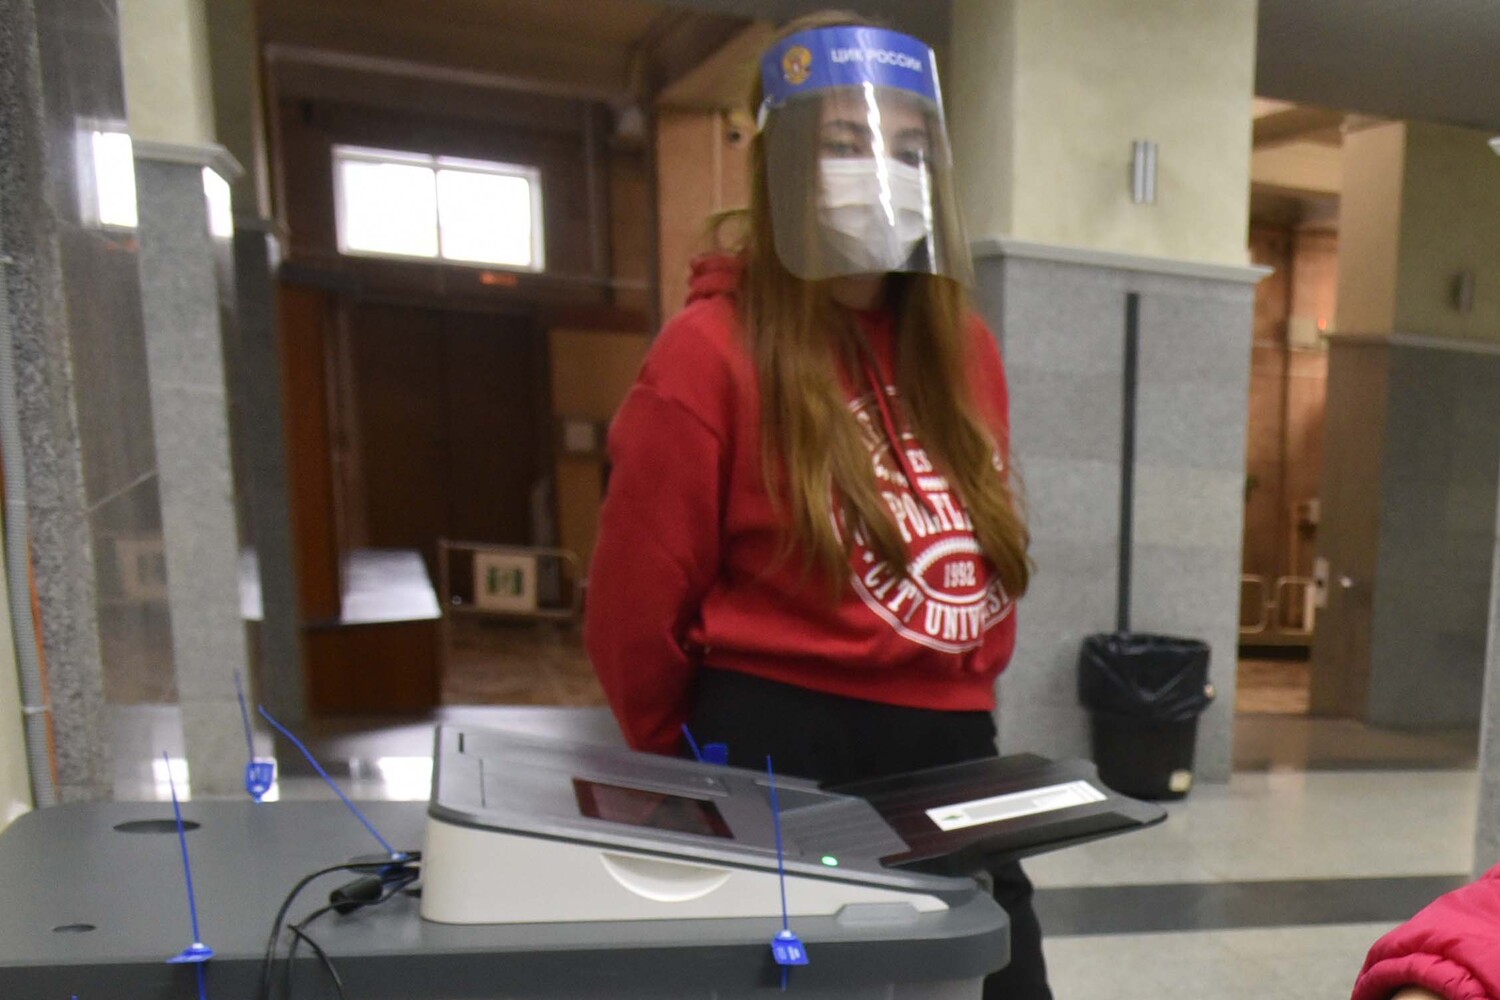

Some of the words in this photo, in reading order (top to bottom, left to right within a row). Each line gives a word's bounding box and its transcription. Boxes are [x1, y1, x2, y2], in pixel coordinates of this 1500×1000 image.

[831, 48, 864, 64] ЦИК
[866, 48, 922, 72] РОССИИ
[943, 560, 976, 588] 1992
[864, 560, 926, 624] CITY
